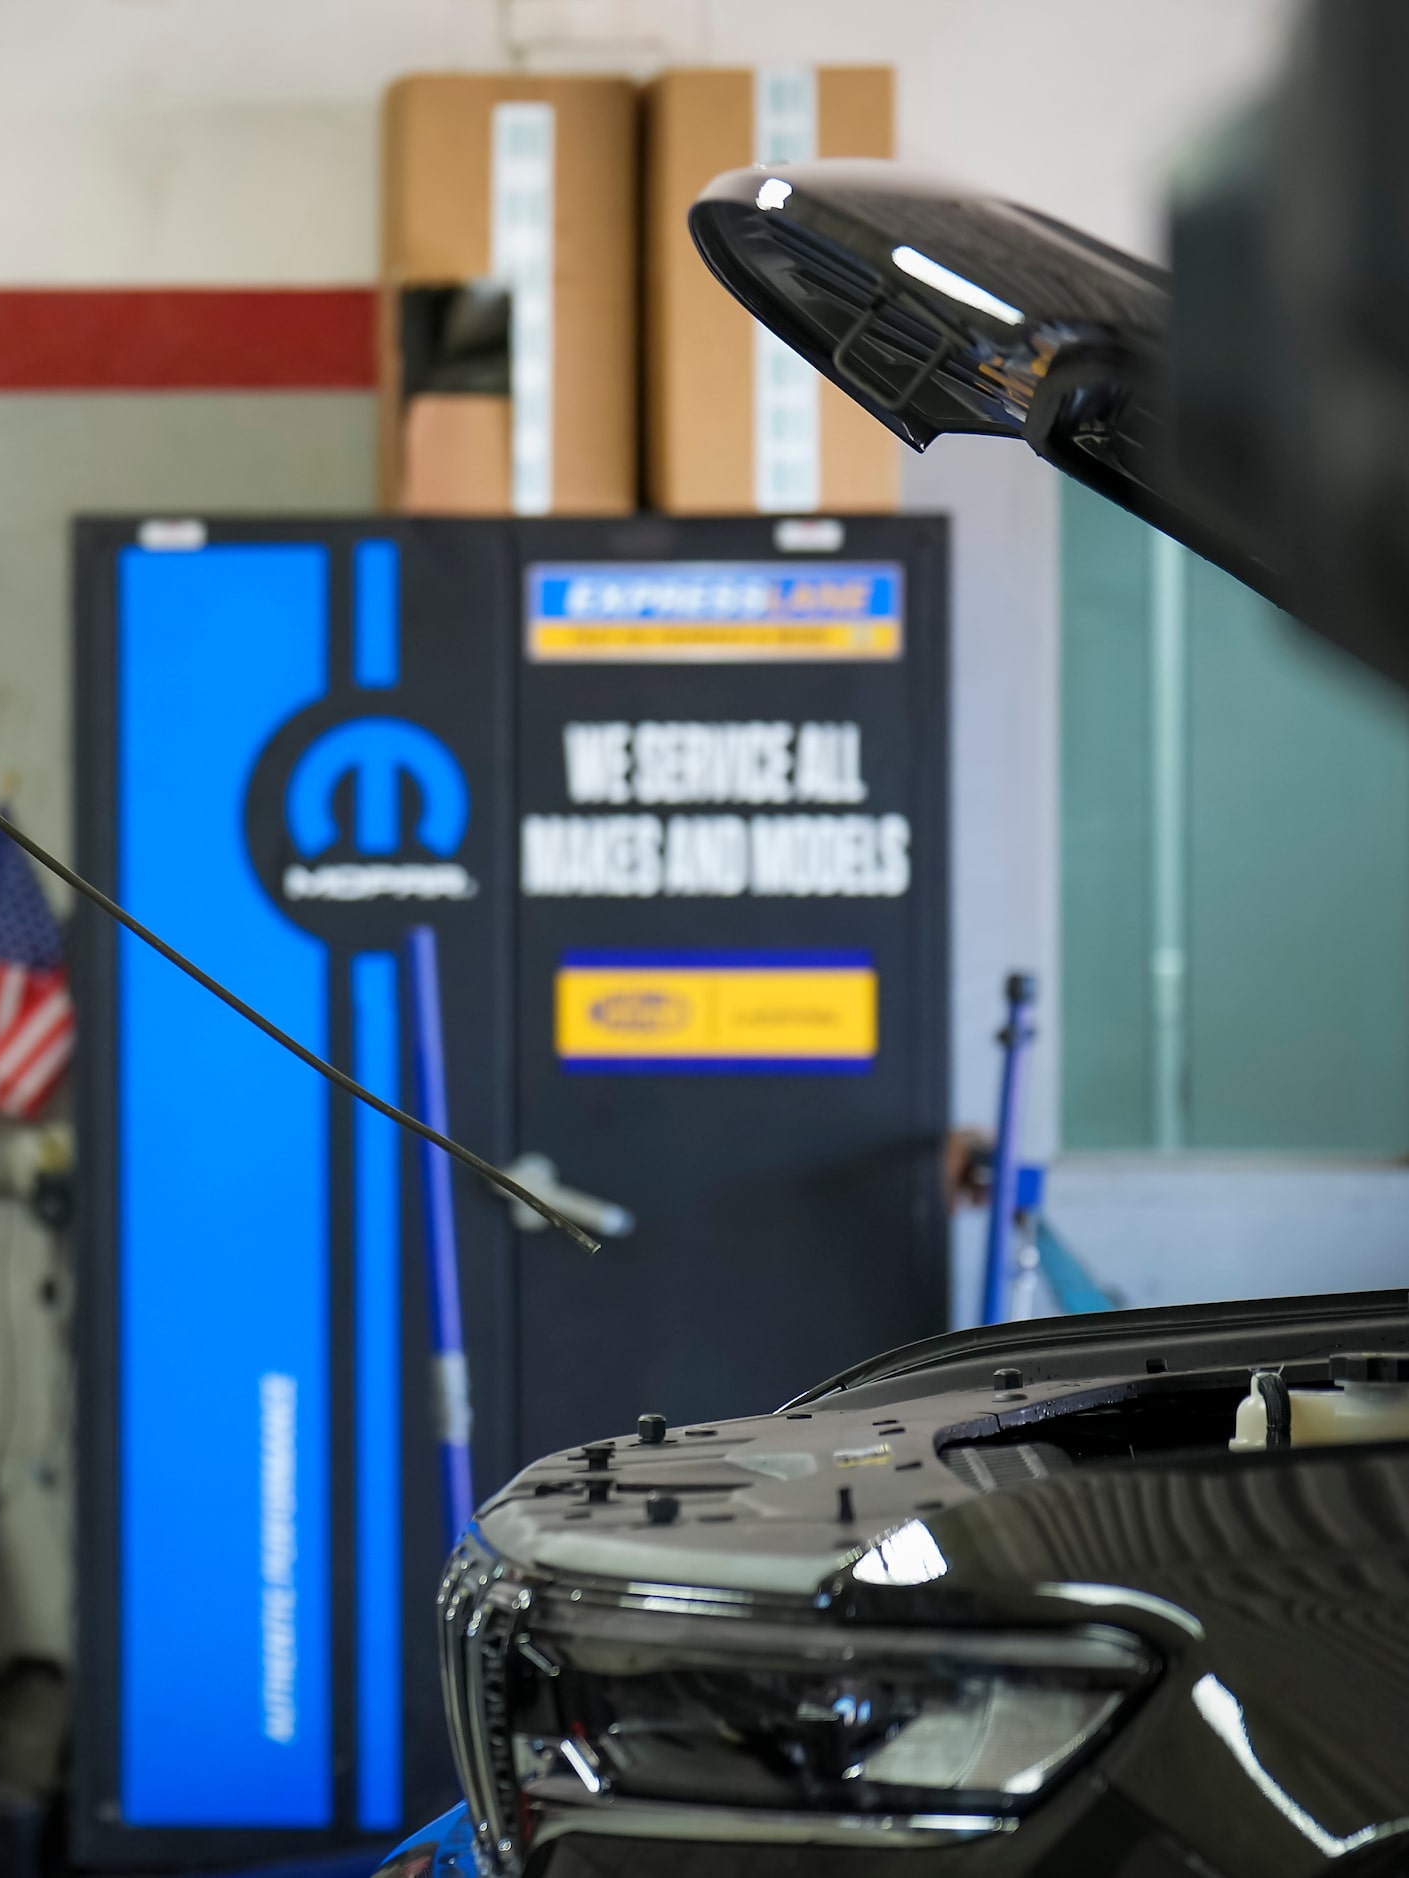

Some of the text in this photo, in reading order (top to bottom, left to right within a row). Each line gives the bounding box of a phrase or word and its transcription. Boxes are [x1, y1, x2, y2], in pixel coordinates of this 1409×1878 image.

[564, 721, 868, 803] WE SERVICE ALL
[521, 813, 910, 897] MAKES AND MODELS
